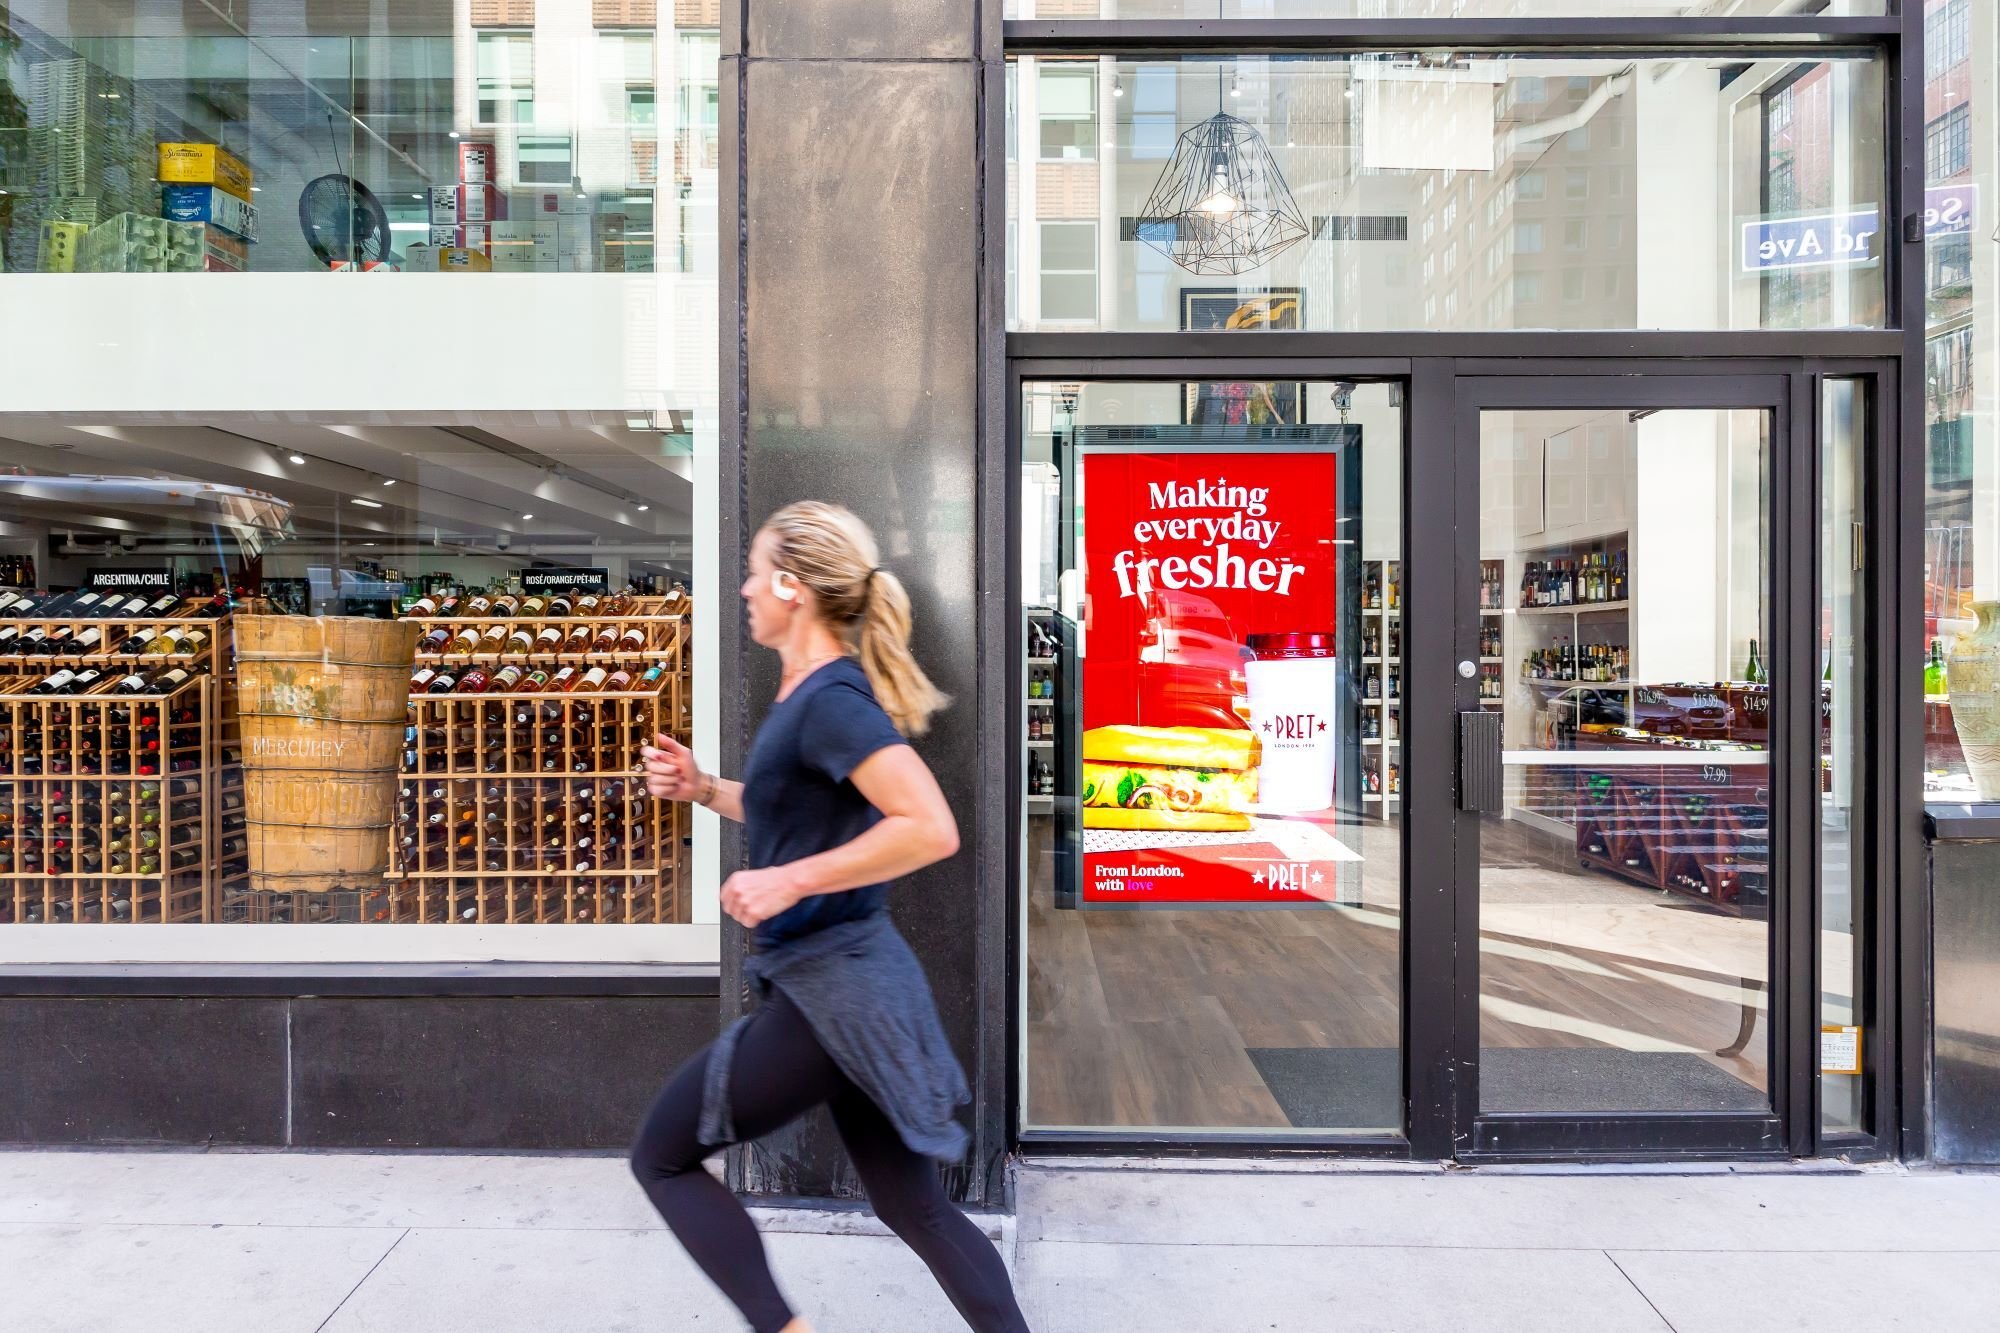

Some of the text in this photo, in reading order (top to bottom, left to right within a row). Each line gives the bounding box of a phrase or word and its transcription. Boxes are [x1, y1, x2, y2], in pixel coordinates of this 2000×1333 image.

[1148, 477, 1269, 516] Making
[1134, 512, 1281, 549] everyday
[93, 573, 170, 586] ARGENTINA/CHILE
[1112, 543, 1305, 598] fresher
[1692, 692, 1719, 707] $15.99
[1275, 714, 1316, 739] PRET
[1703, 764, 1727, 783] $7.99
[1095, 865, 1184, 879] From London,
[1268, 864, 1310, 891] PRET
[1095, 879, 1154, 891] with love
